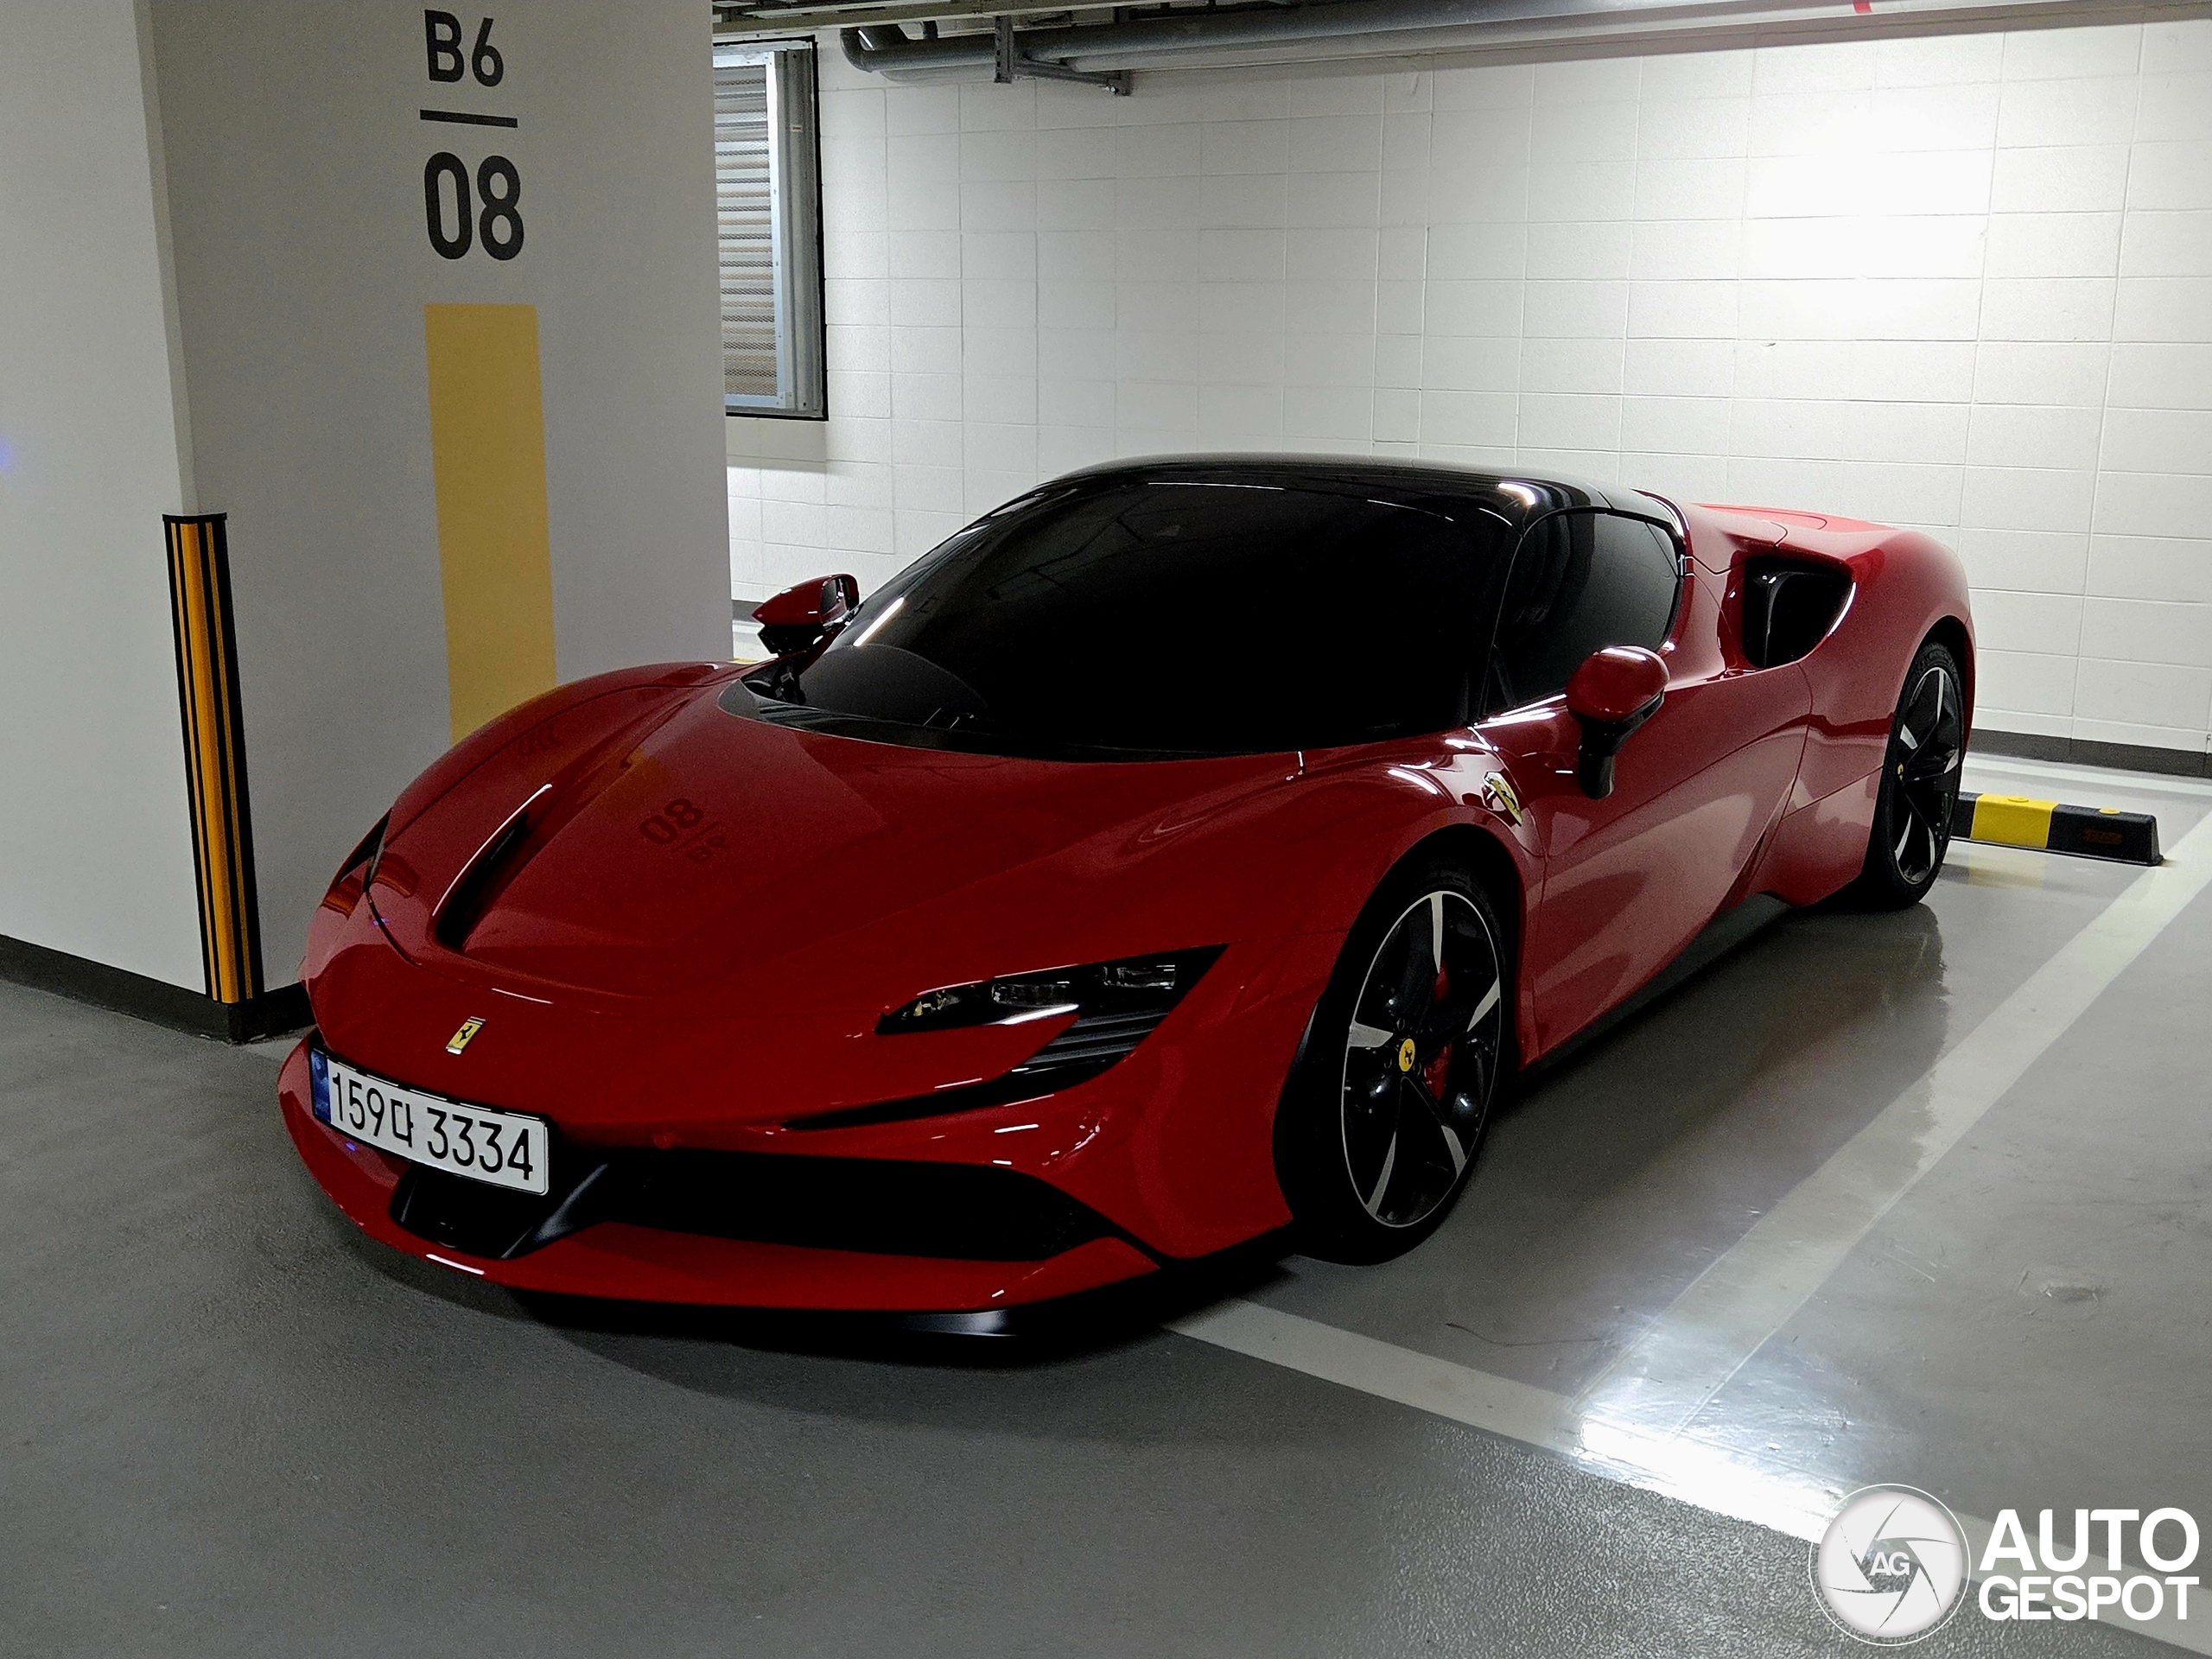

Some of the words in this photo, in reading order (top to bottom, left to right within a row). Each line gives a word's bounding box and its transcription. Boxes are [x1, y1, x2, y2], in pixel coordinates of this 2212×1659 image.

[424, 9, 504, 87] B6
[424, 151, 524, 261] 08
[333, 1072, 414, 1148] 159다
[427, 1107, 533, 1180] 3334
